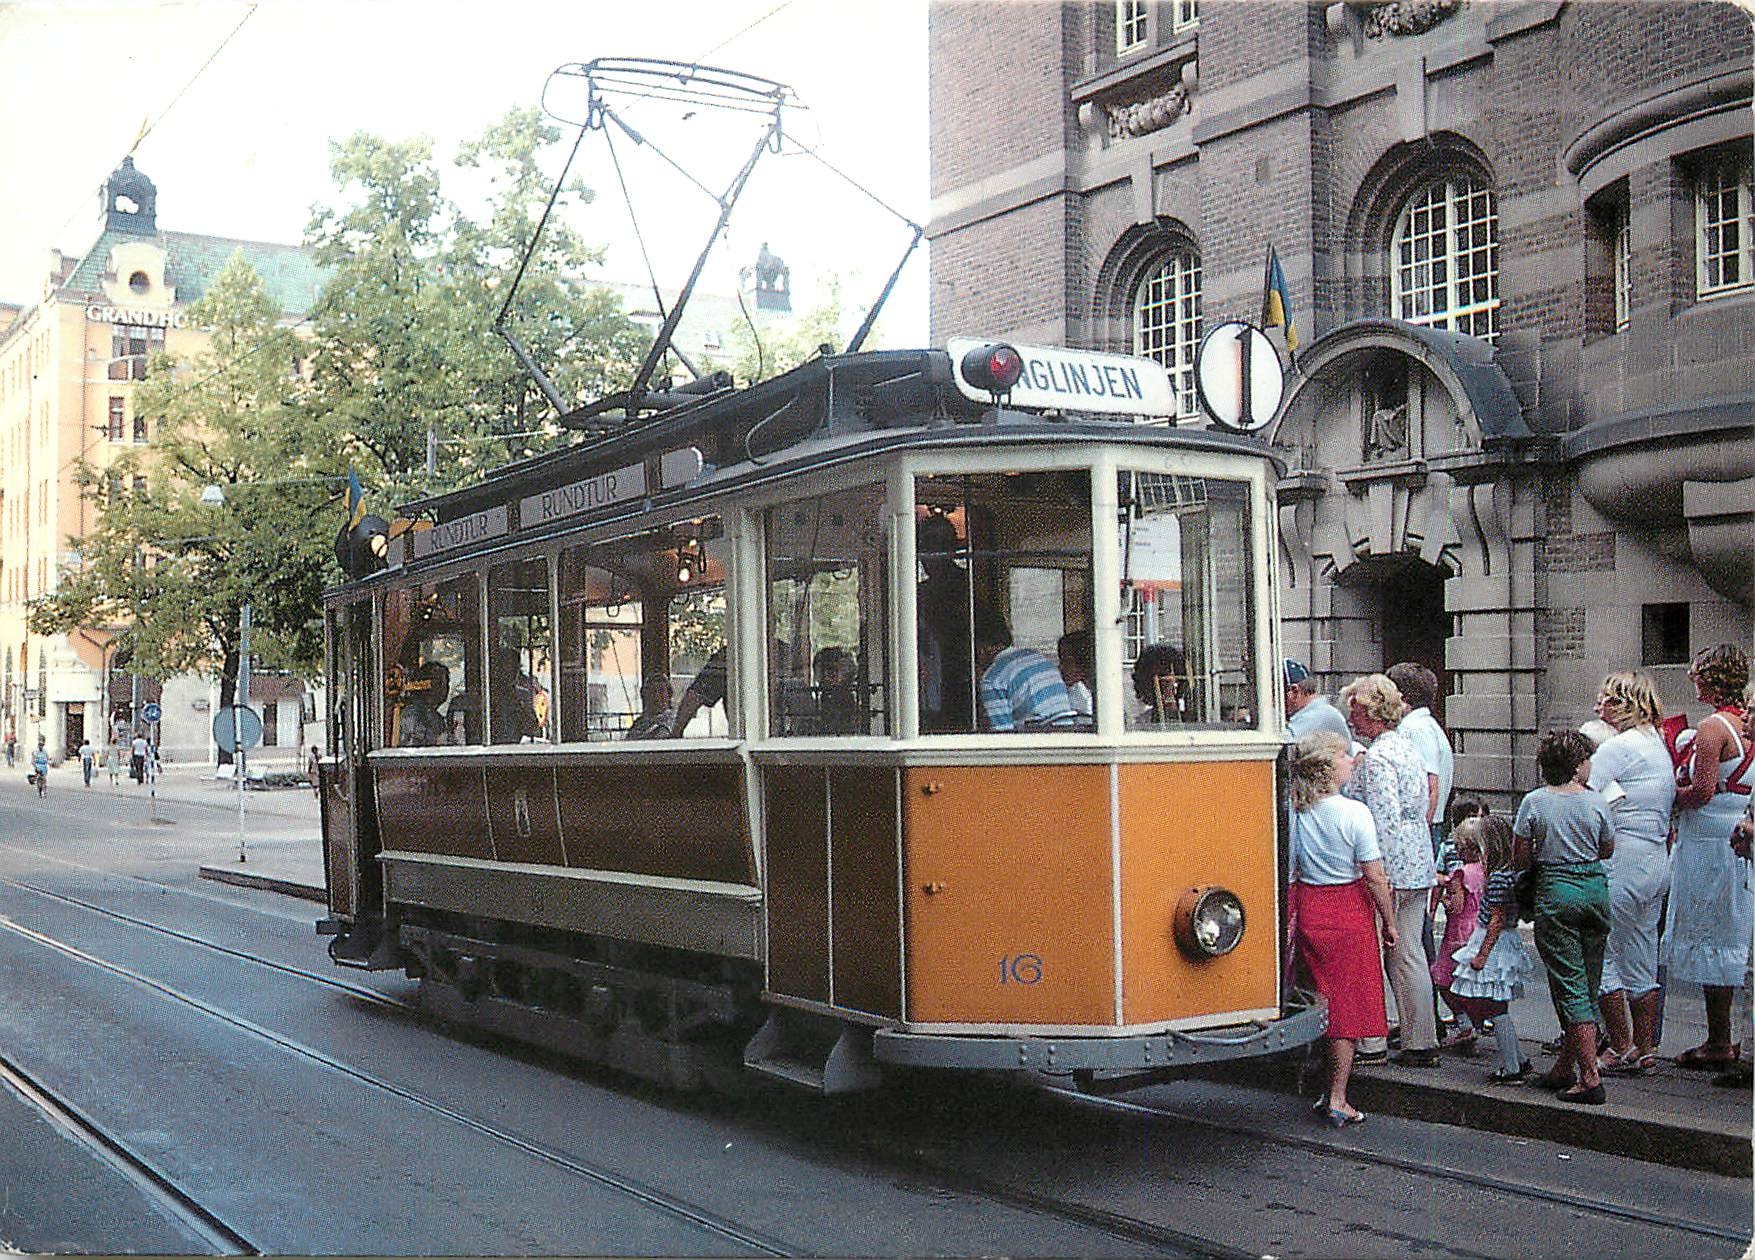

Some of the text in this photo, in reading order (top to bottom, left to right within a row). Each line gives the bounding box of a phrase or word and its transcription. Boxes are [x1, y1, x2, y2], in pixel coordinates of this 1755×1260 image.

[87, 304, 191, 329] GRAND HO
[1017, 359, 1143, 400] NGLINJEN
[1229, 326, 1254, 424] 1
[542, 475, 617, 520] RUNDTUR
[998, 953, 1044, 985] 16
